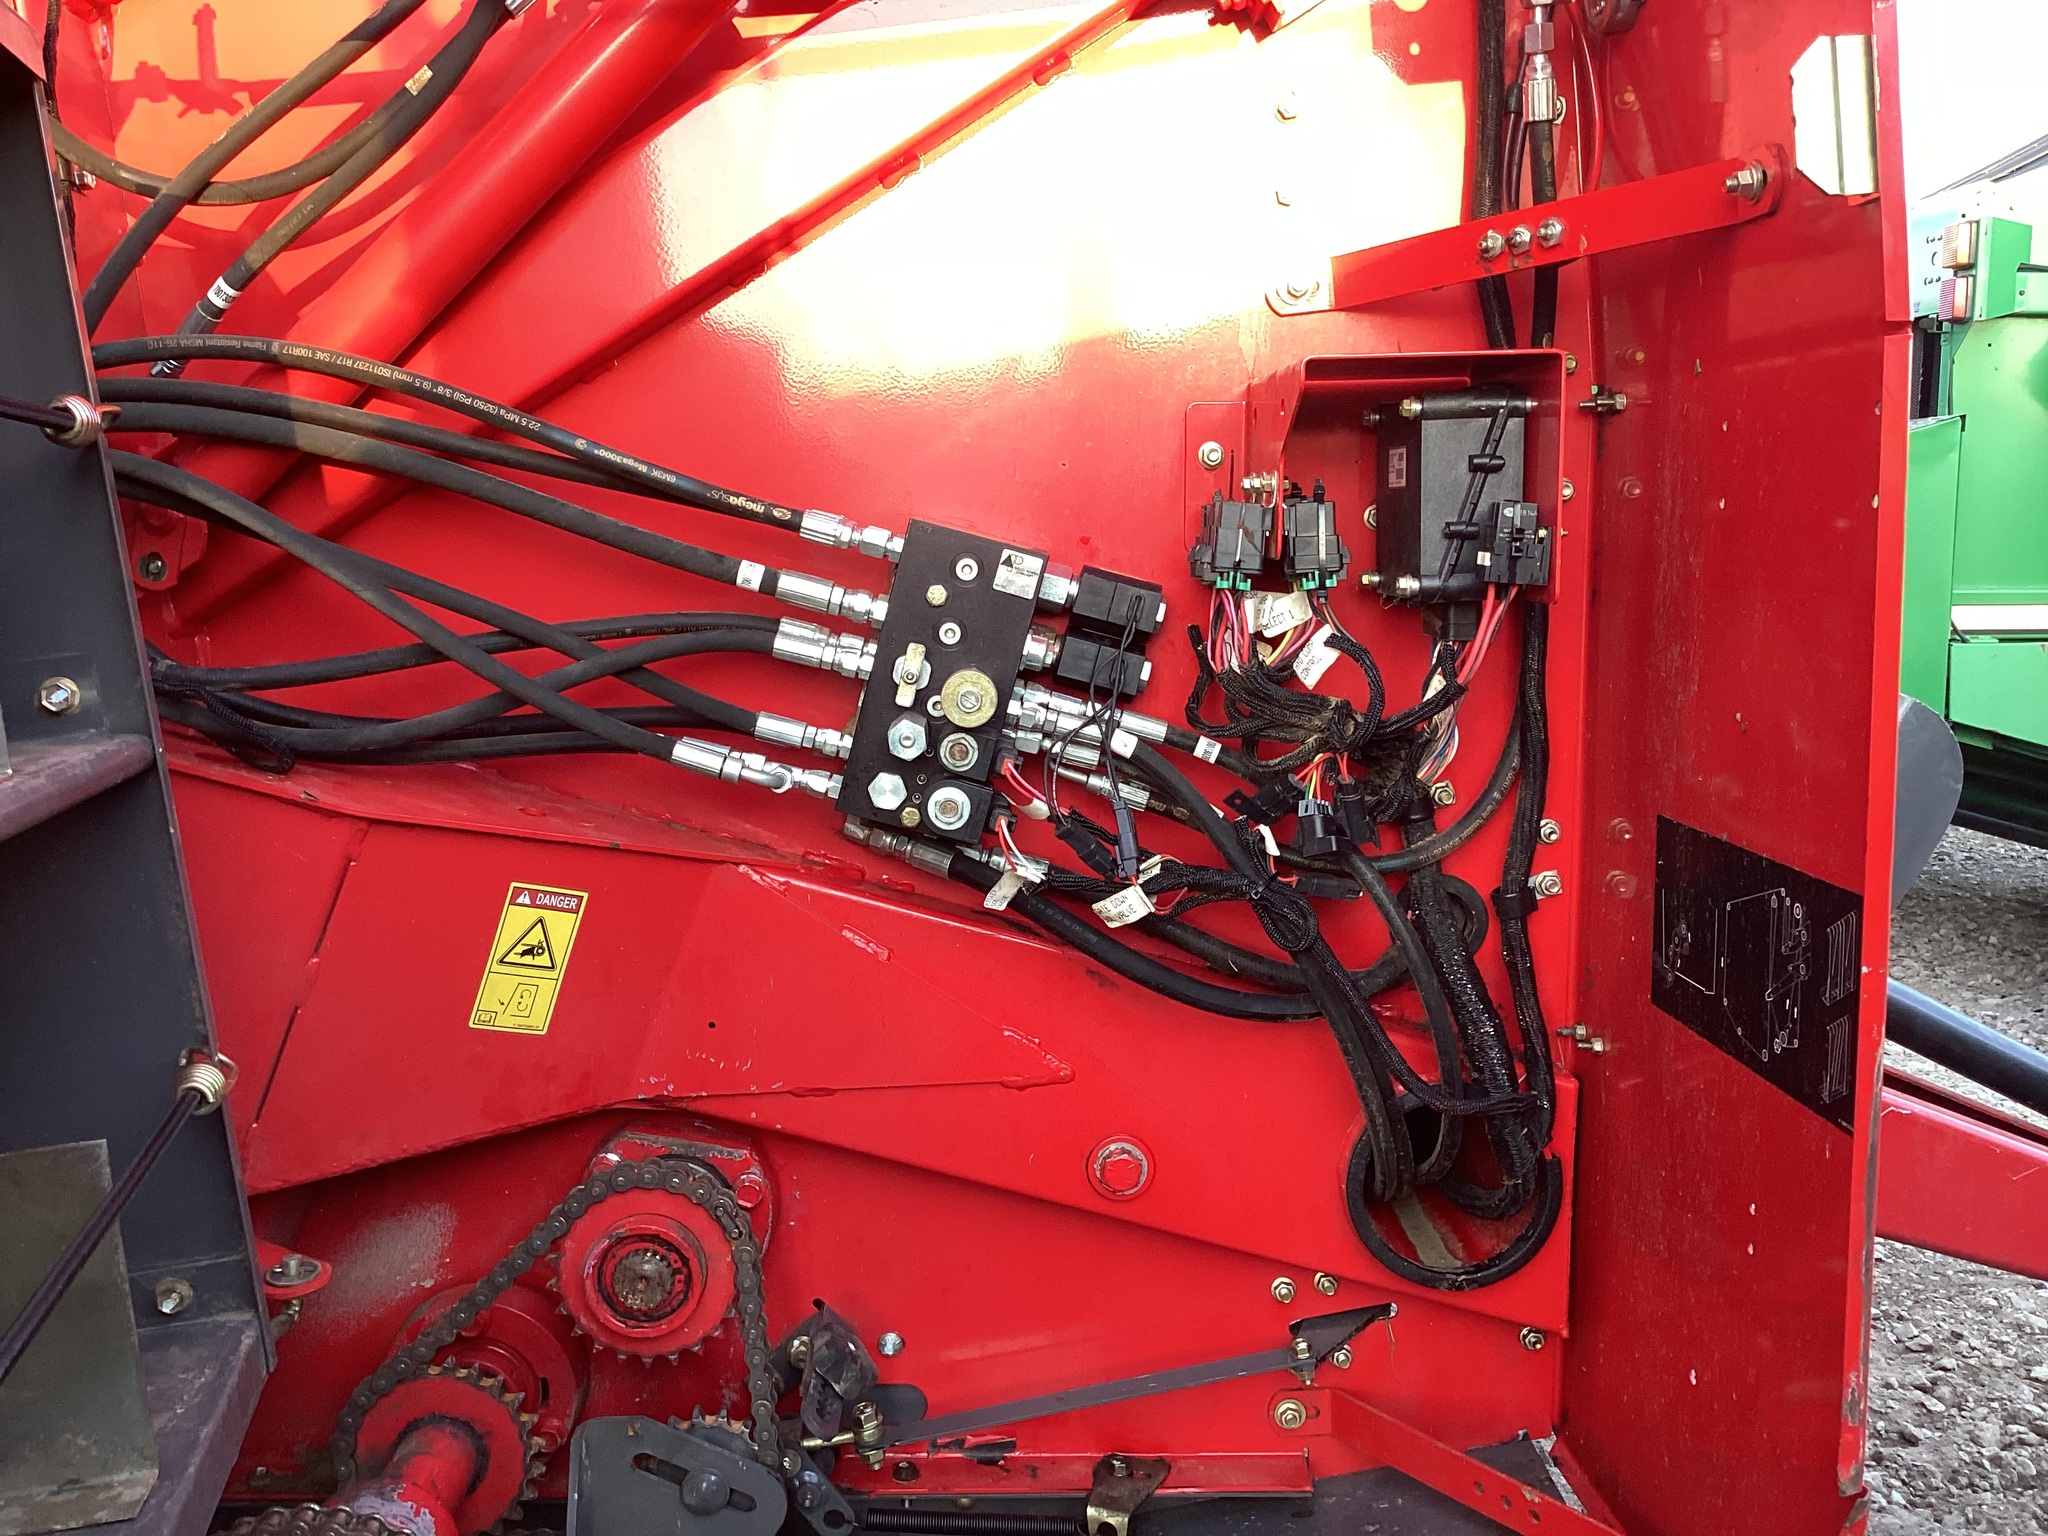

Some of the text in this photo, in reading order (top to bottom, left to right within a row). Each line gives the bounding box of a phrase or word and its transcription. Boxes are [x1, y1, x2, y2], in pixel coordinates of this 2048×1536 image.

[204, 338, 241, 349] Resistant
[243, 341, 267, 351] Flame
[282, 345, 312, 358] 100R17
[314, 350, 331, 362] SAE
[336, 356, 353, 368] R17
[392, 370, 413, 383] mm)
[414, 378, 432, 391] (9.5
[453, 391, 472, 405] PSI)
[473, 400, 498, 415] (3250
[499, 408, 520, 424] MPa
[521, 417, 541, 431] 22.5
[651, 468, 677, 483] 6M3K
[535, 892, 578, 910] DANGER
[1111, 894, 1129, 909] DOWN
